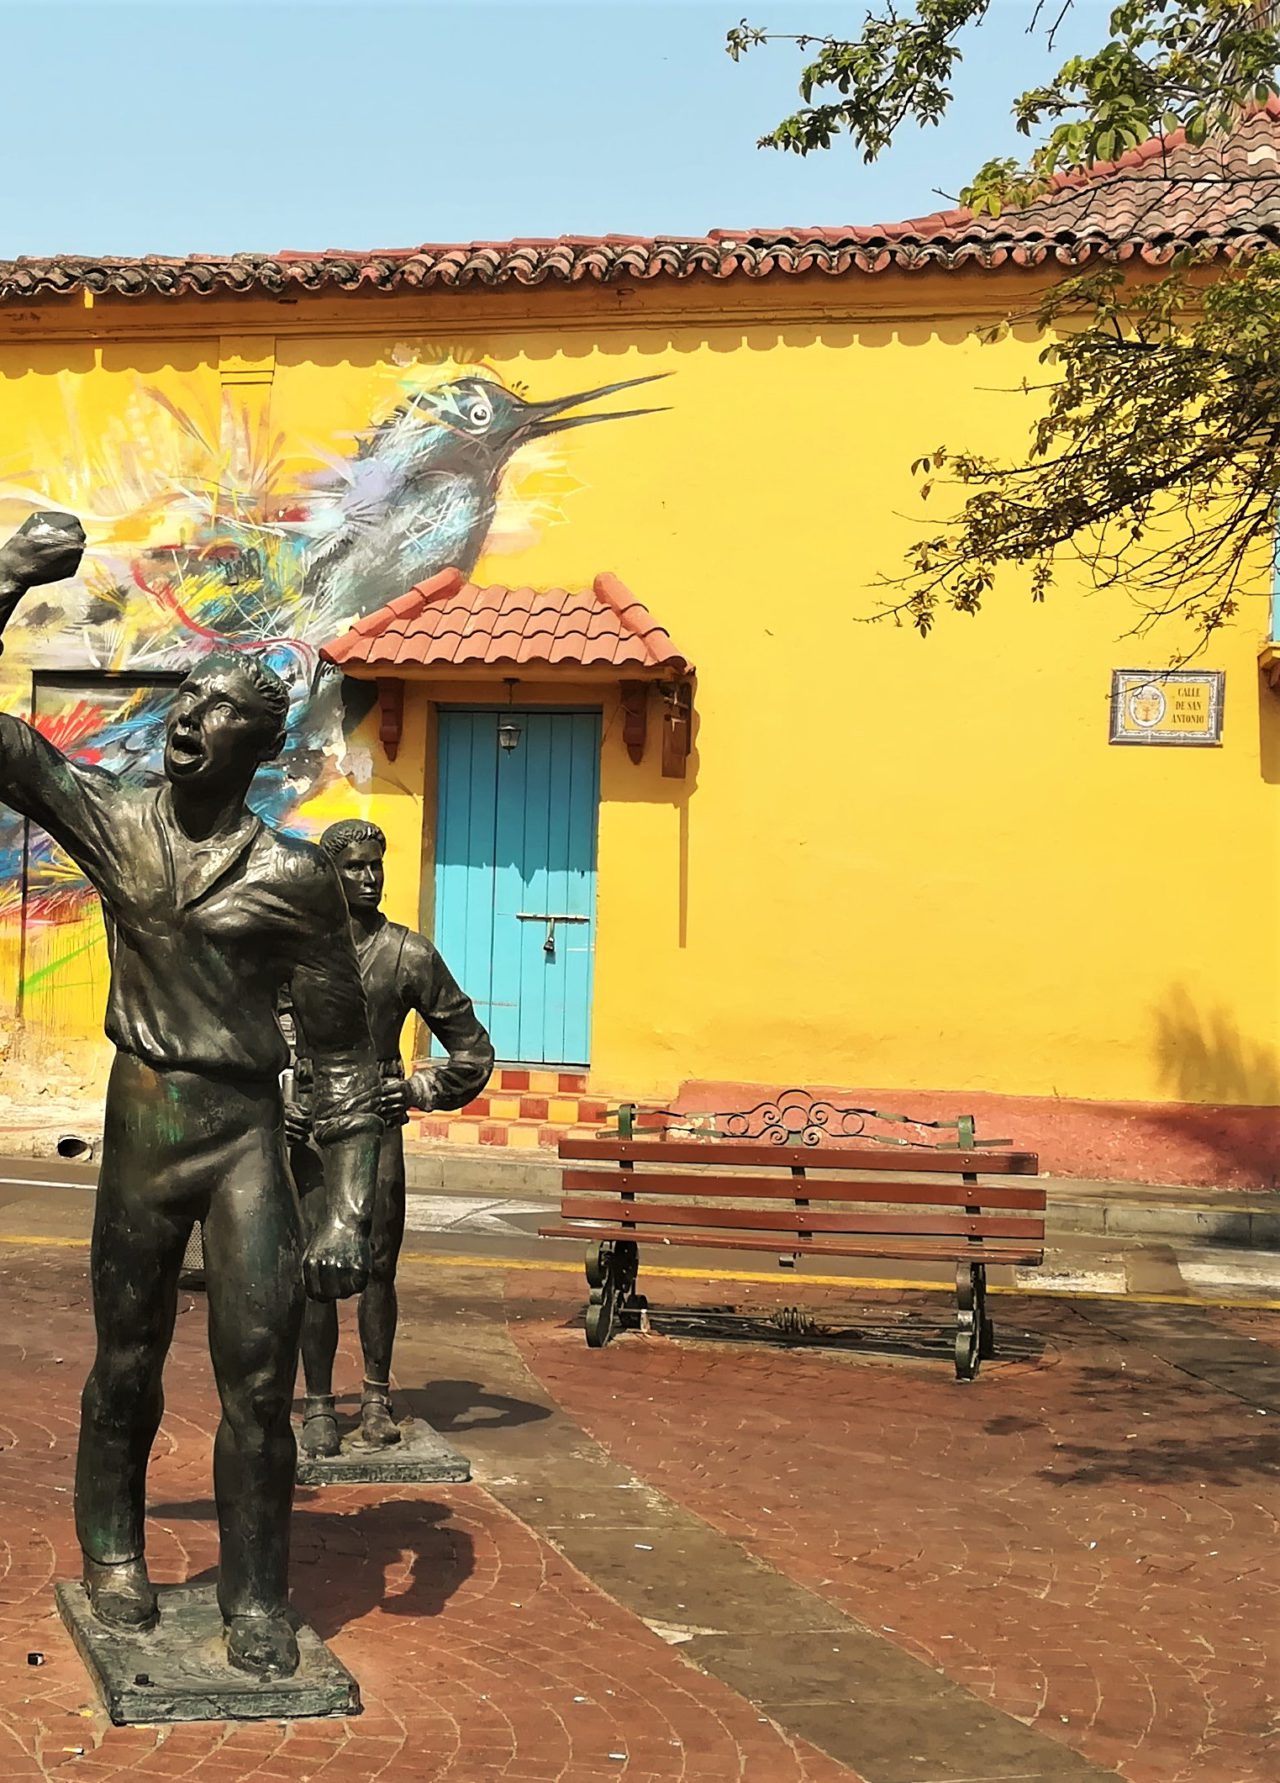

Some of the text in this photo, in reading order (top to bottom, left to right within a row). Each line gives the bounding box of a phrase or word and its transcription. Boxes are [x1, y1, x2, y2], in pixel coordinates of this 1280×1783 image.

[1177, 688, 1200, 697] CALLE
[1175, 701, 1202, 710] DE SAN
[1172, 714, 1204, 723] ANTONIO
